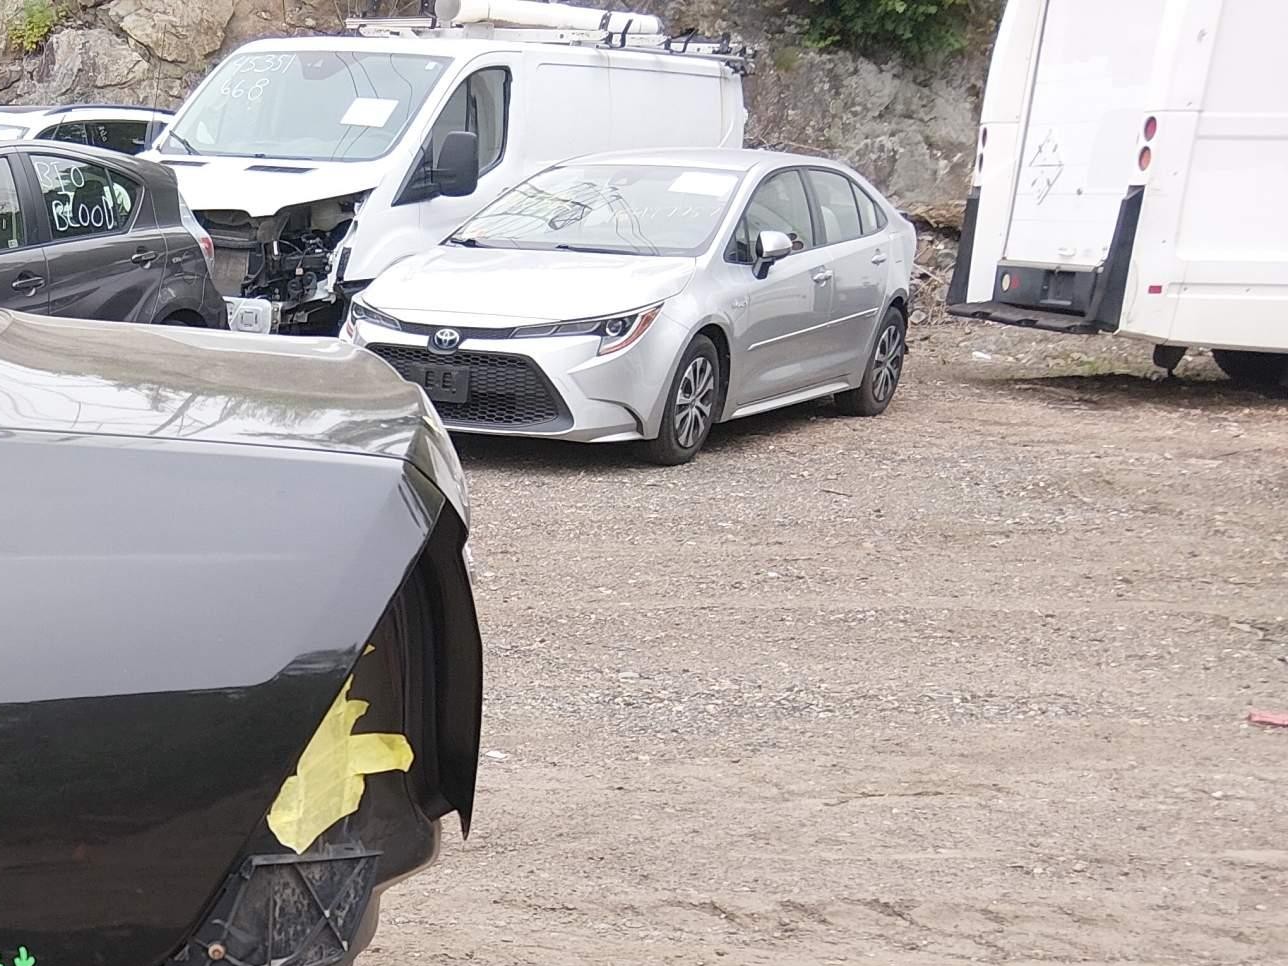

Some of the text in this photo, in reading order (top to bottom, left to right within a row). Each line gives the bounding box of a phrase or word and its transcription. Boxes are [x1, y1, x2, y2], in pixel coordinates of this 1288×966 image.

[219, 78, 271, 102] 668
[34, 161, 86, 193] BIO
[52, 199, 115, 231] BLOOD
